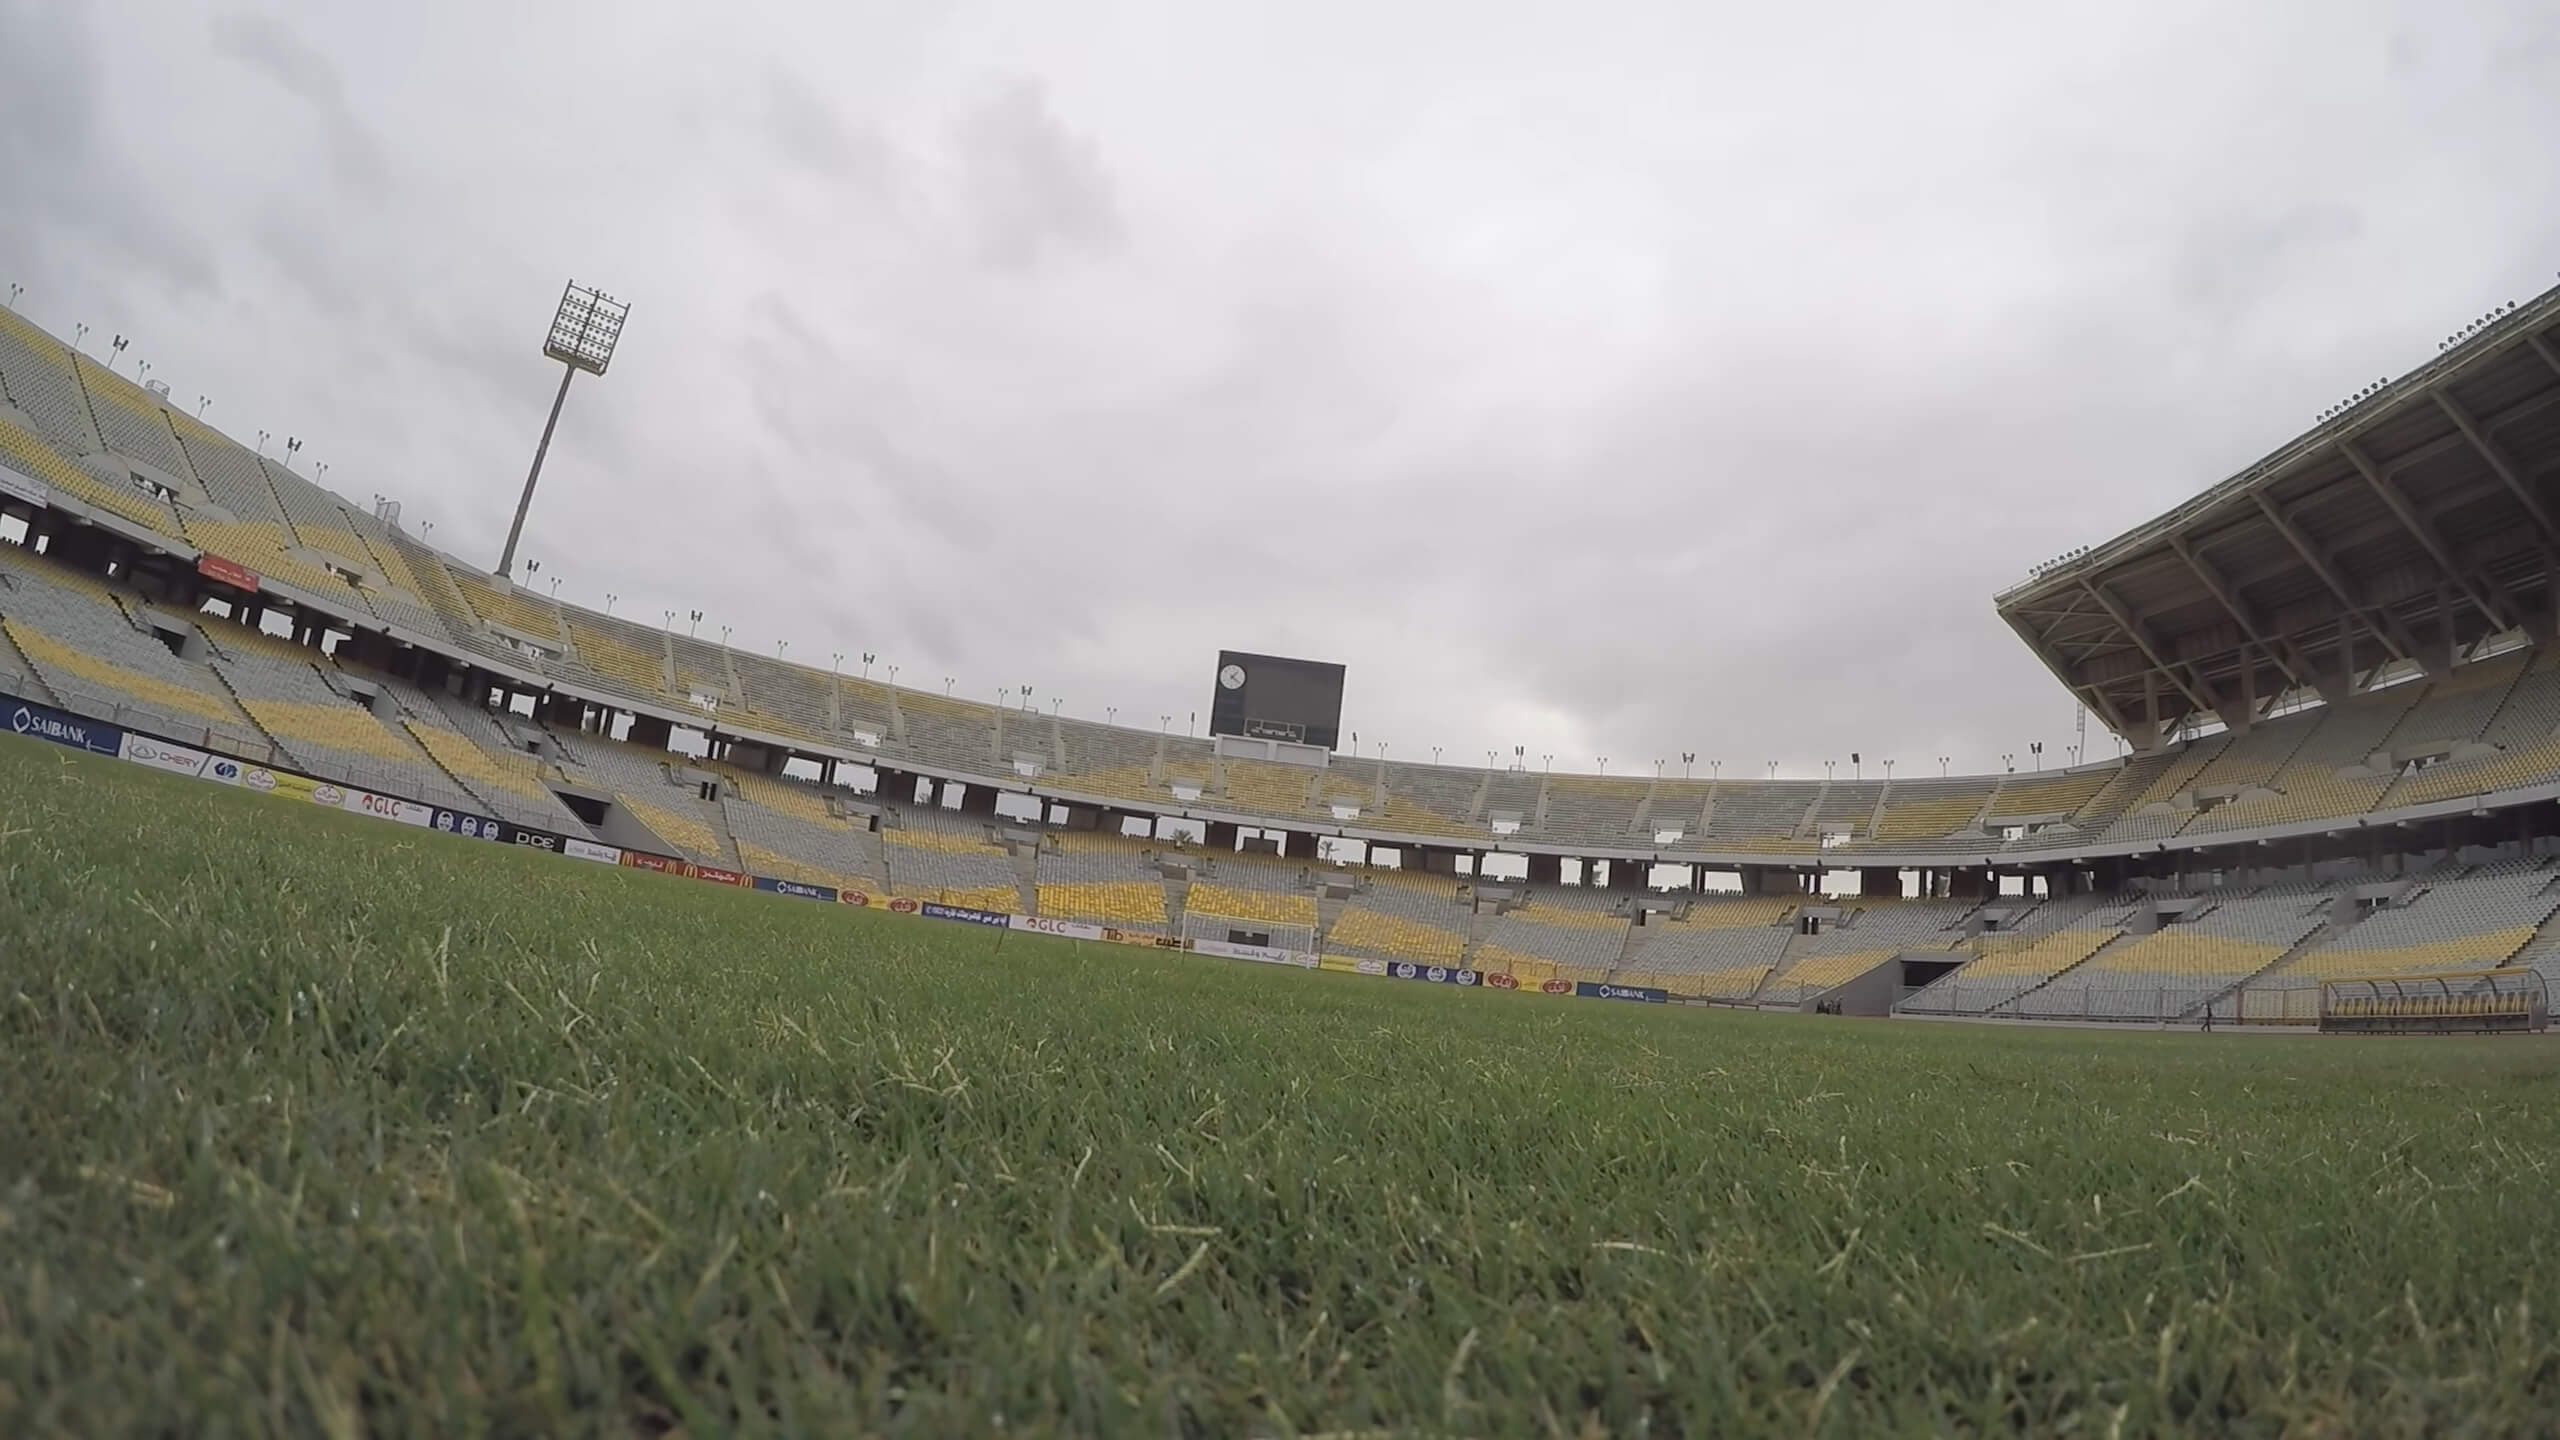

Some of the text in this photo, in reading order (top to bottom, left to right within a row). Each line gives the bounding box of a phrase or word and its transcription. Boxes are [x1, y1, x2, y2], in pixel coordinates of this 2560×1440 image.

[31, 716, 87, 744] SAIBANK
[159, 751, 199, 769] CHERY
[374, 797, 401, 817] GLC
[1039, 919, 1066, 933] GLC
